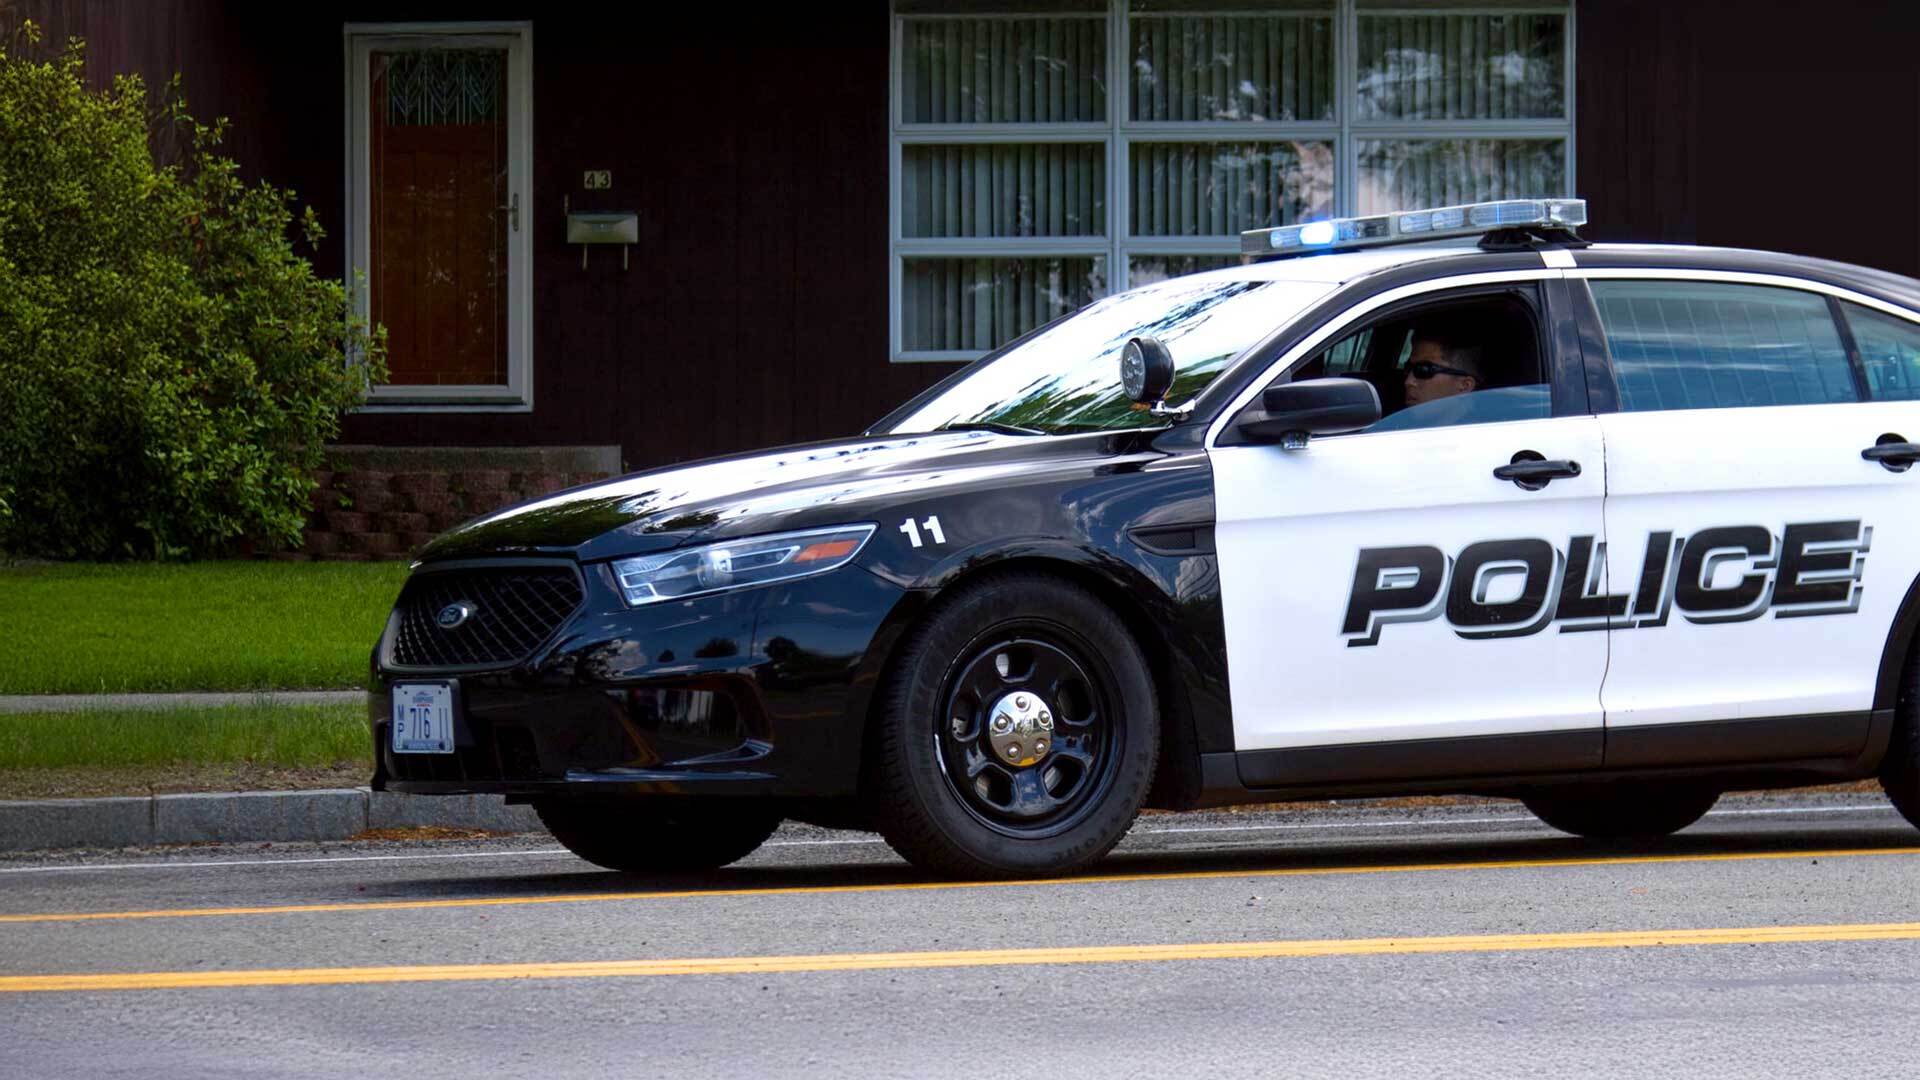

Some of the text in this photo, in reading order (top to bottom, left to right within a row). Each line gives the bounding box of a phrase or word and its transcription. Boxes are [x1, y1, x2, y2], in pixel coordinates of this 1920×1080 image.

[585, 171, 610, 189] 43
[899, 516, 946, 548] 11
[1340, 519, 1873, 648] POLICE
